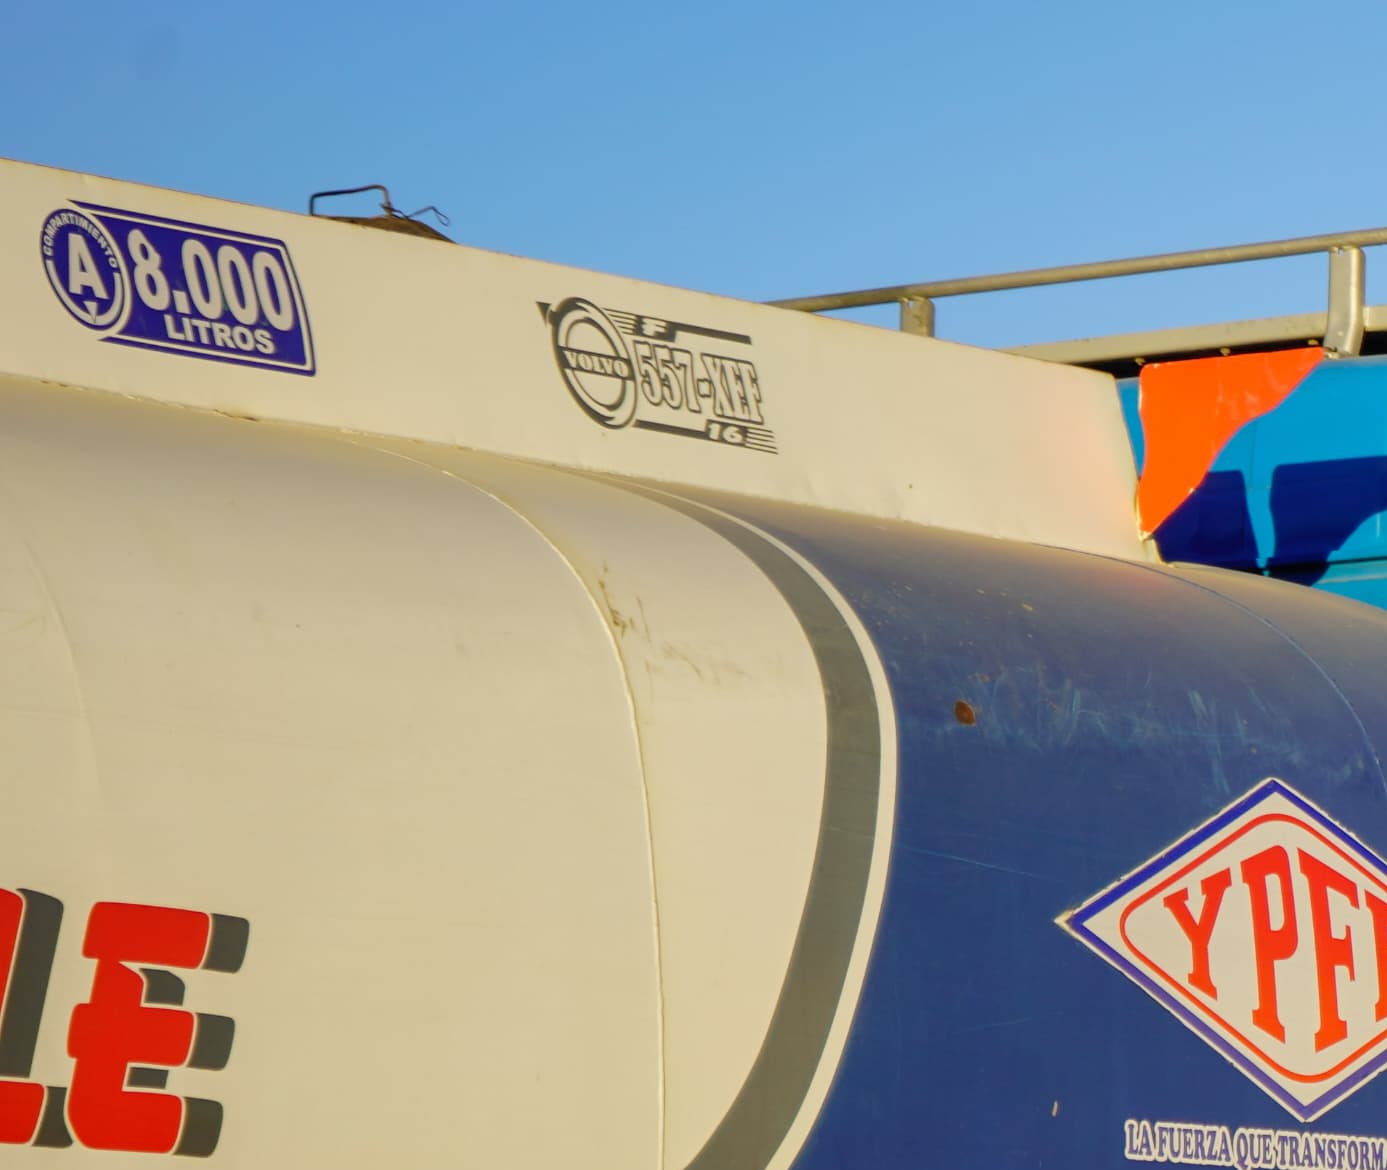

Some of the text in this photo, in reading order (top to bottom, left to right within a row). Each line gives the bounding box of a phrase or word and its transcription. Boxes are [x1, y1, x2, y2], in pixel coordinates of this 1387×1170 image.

[43, 211, 117, 268] COMPARTIMIENTO
[67, 232, 109, 299] A
[127, 228, 294, 332] 8.000
[164, 313, 275, 354] LITROS
[565, 352, 629, 379] VOLVO
[707, 423, 745, 444] 16
[1125, 1121, 1152, 1158] LA
[1156, 1124, 1232, 1164] FUERZA
